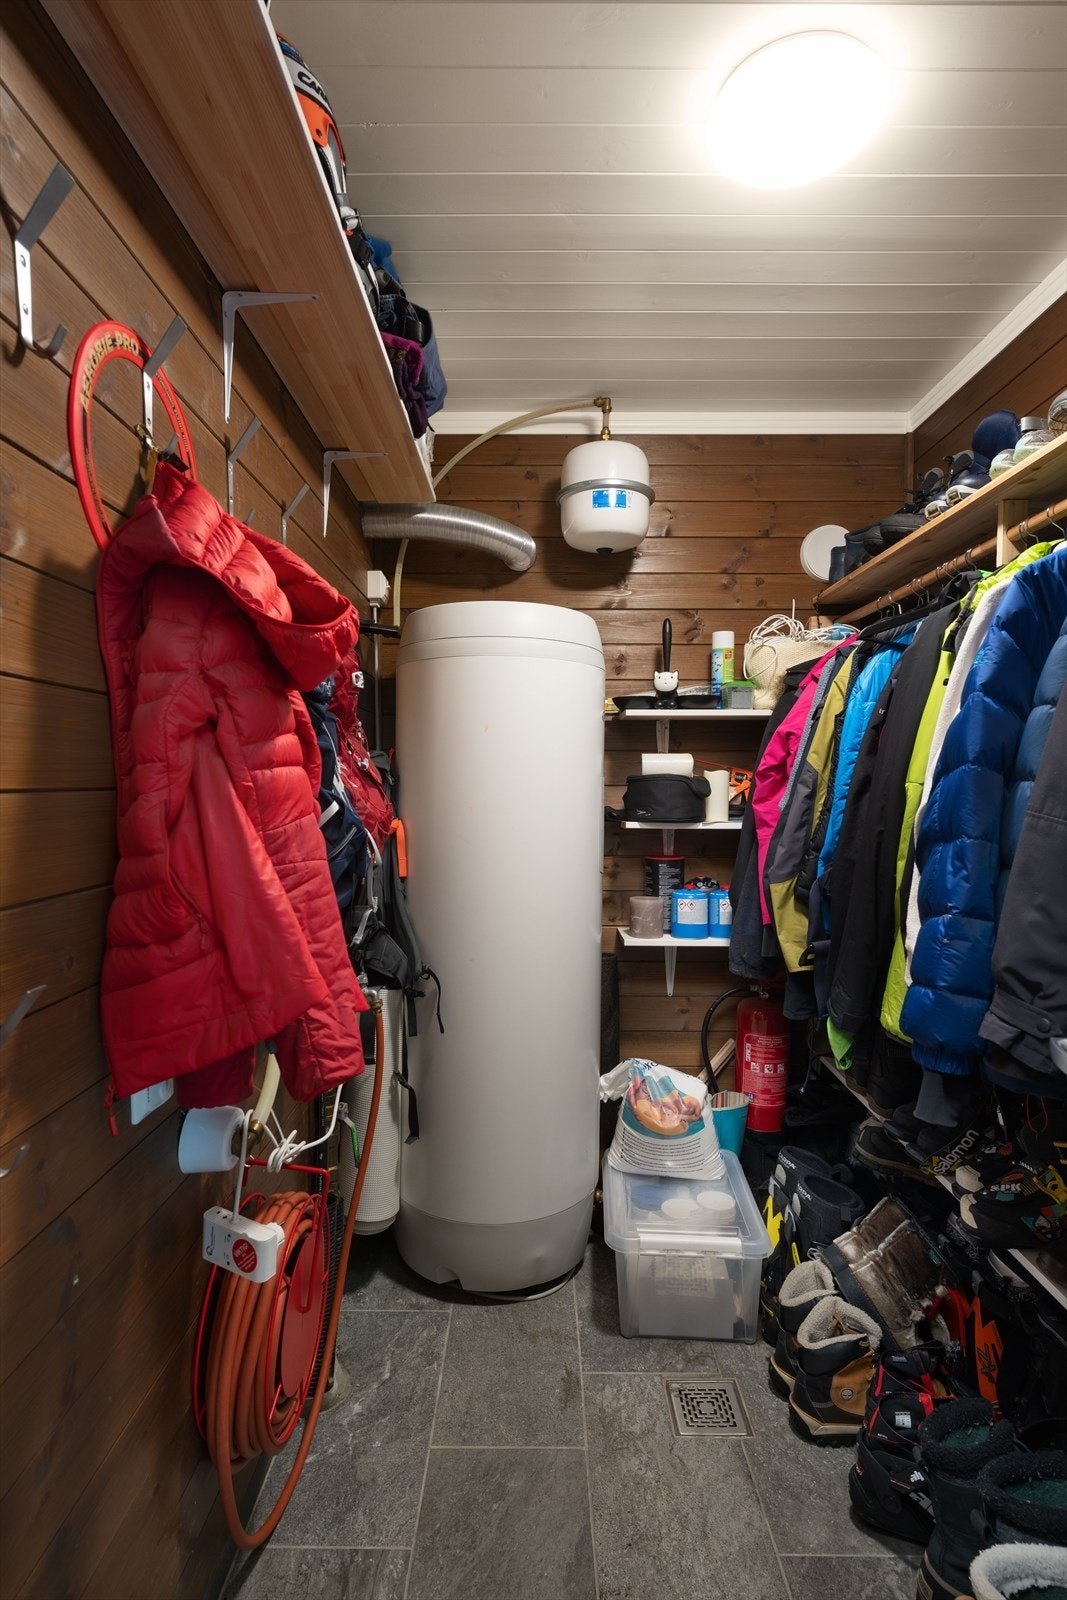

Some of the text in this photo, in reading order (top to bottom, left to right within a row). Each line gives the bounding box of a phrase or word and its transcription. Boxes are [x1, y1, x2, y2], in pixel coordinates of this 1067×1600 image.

[80, 331, 114, 414] AEROBIE
[114, 331, 139, 356] PRO
[933, 1129, 979, 1175] salomon
